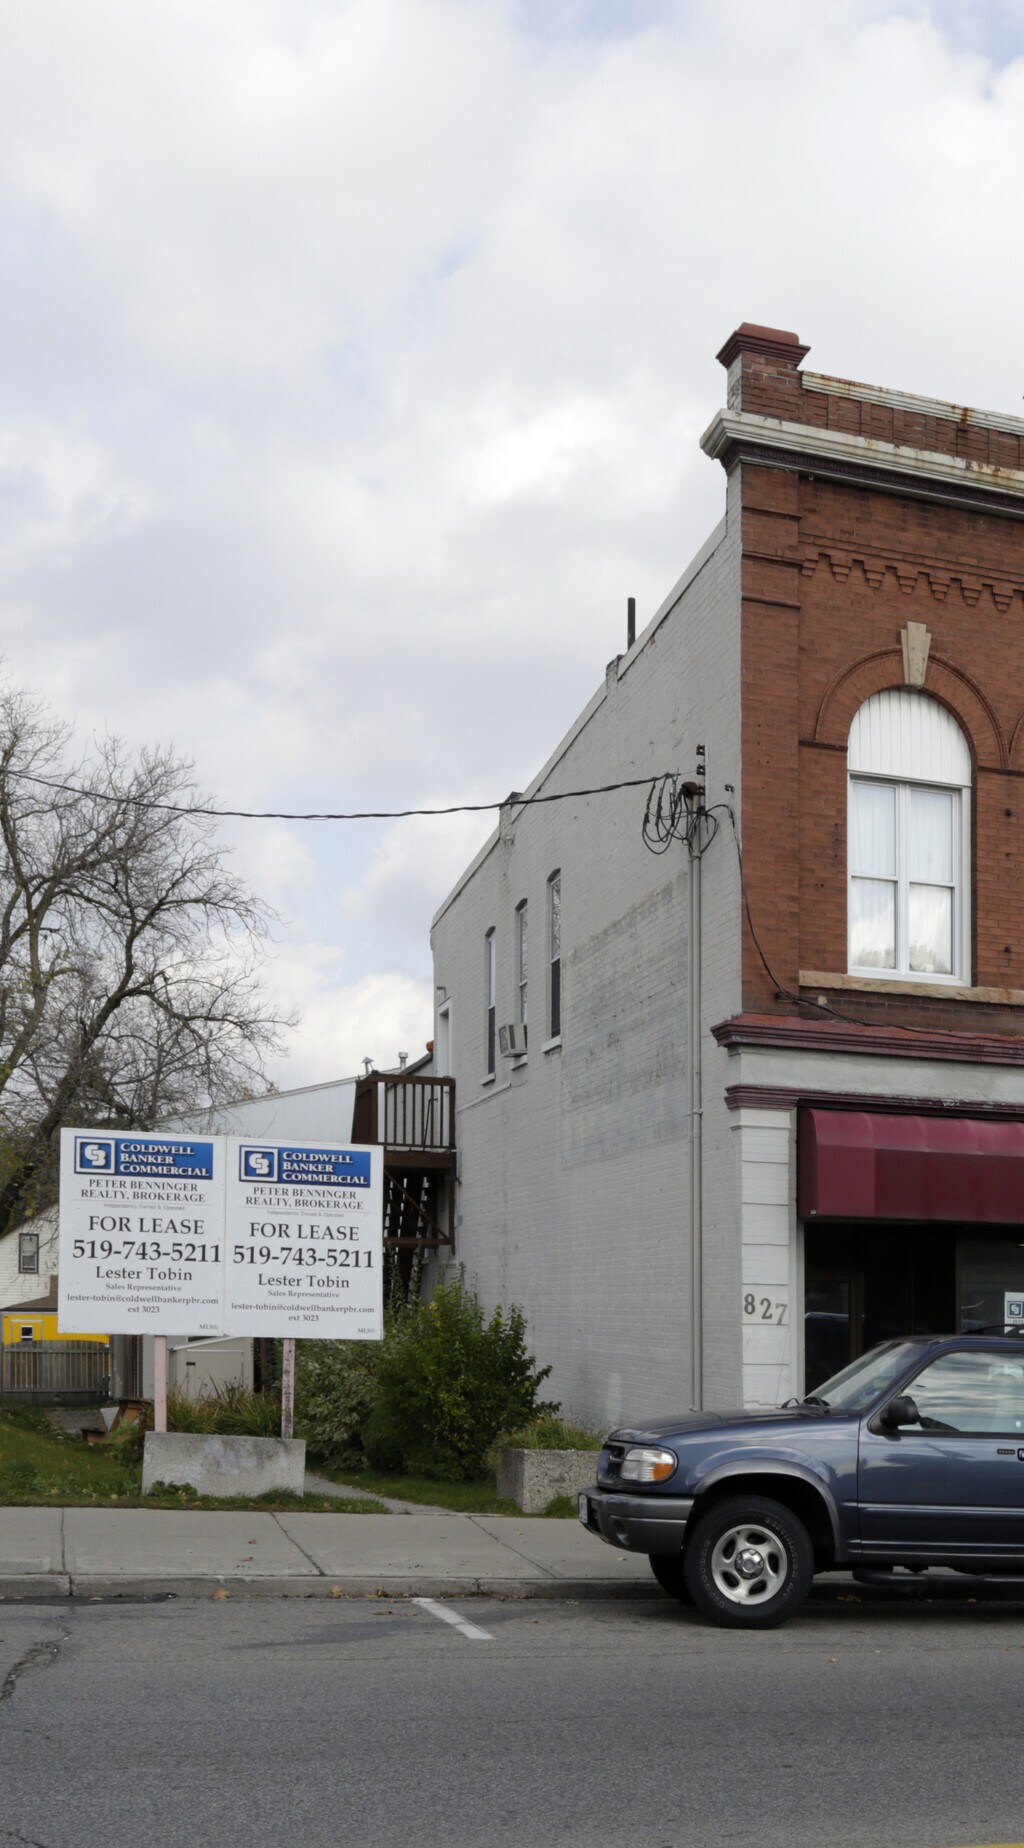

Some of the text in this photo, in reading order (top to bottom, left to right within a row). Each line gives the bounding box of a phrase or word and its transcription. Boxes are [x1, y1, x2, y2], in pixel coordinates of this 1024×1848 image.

[119, 1142, 195, 1155] COLDWELL
[120, 1153, 174, 1164] BANKER
[282, 1151, 353, 1164] COLDWELL
[119, 1163, 210, 1176] COMMERCIAL
[283, 1161, 334, 1173] BANKER
[282, 1172, 367, 1184] COMMERCIAL
[89, 1178, 198, 1192] PETER BENNINGER
[81, 1189, 206, 1203] REALTY, BROKERAGE
[253, 1186, 357, 1200] PETER BENNINGER
[245, 1197, 364, 1210] REALTY, BROKERAGE
[88, 1215, 205, 1235] FOR LEASE
[249, 1222, 360, 1241] FOR LEASE
[72, 1239, 222, 1263] 519-743-5211
[232, 1245, 375, 1268] 519-743-5211
[95, 1265, 193, 1281] Lester Tobin
[127, 1283, 182, 1292] Representative
[258, 1273, 350, 1289] Lester Tobin
[67, 1293, 219, 1306] lester-tobin@coldwellbankerpbr.com
[288, 1291, 340, 1299] Representative
[231, 1302, 375, 1314] lester-tobin@coldwellbankerpbr.com
[744, 1293, 788, 1325] 827
[302, 1314, 319, 1322] 3023
